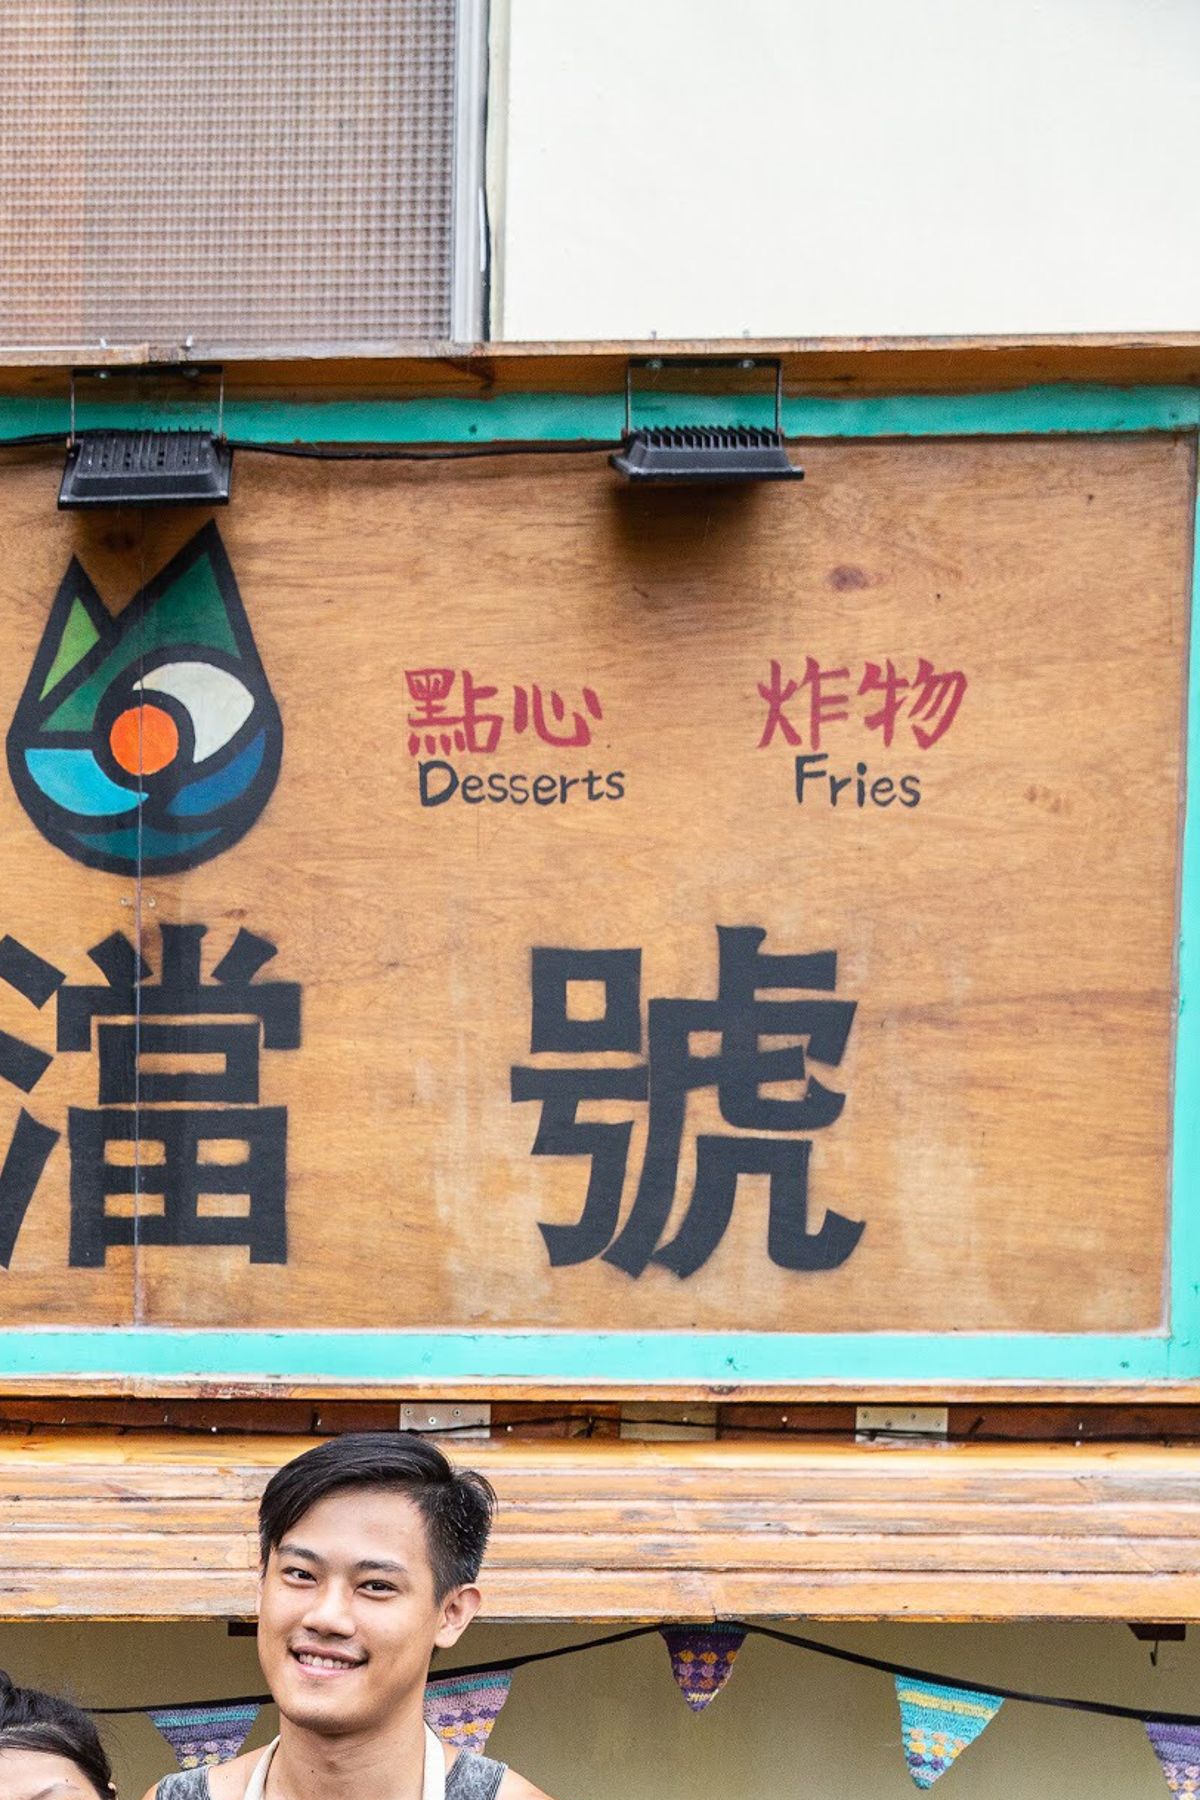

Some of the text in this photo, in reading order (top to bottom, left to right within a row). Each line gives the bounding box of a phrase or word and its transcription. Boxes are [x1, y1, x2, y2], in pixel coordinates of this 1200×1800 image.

[404, 667, 603, 756] 點心
[756, 656, 968, 749] 炸物
[417, 760, 625, 807] Desserts
[794, 753, 921, 808] Fries
